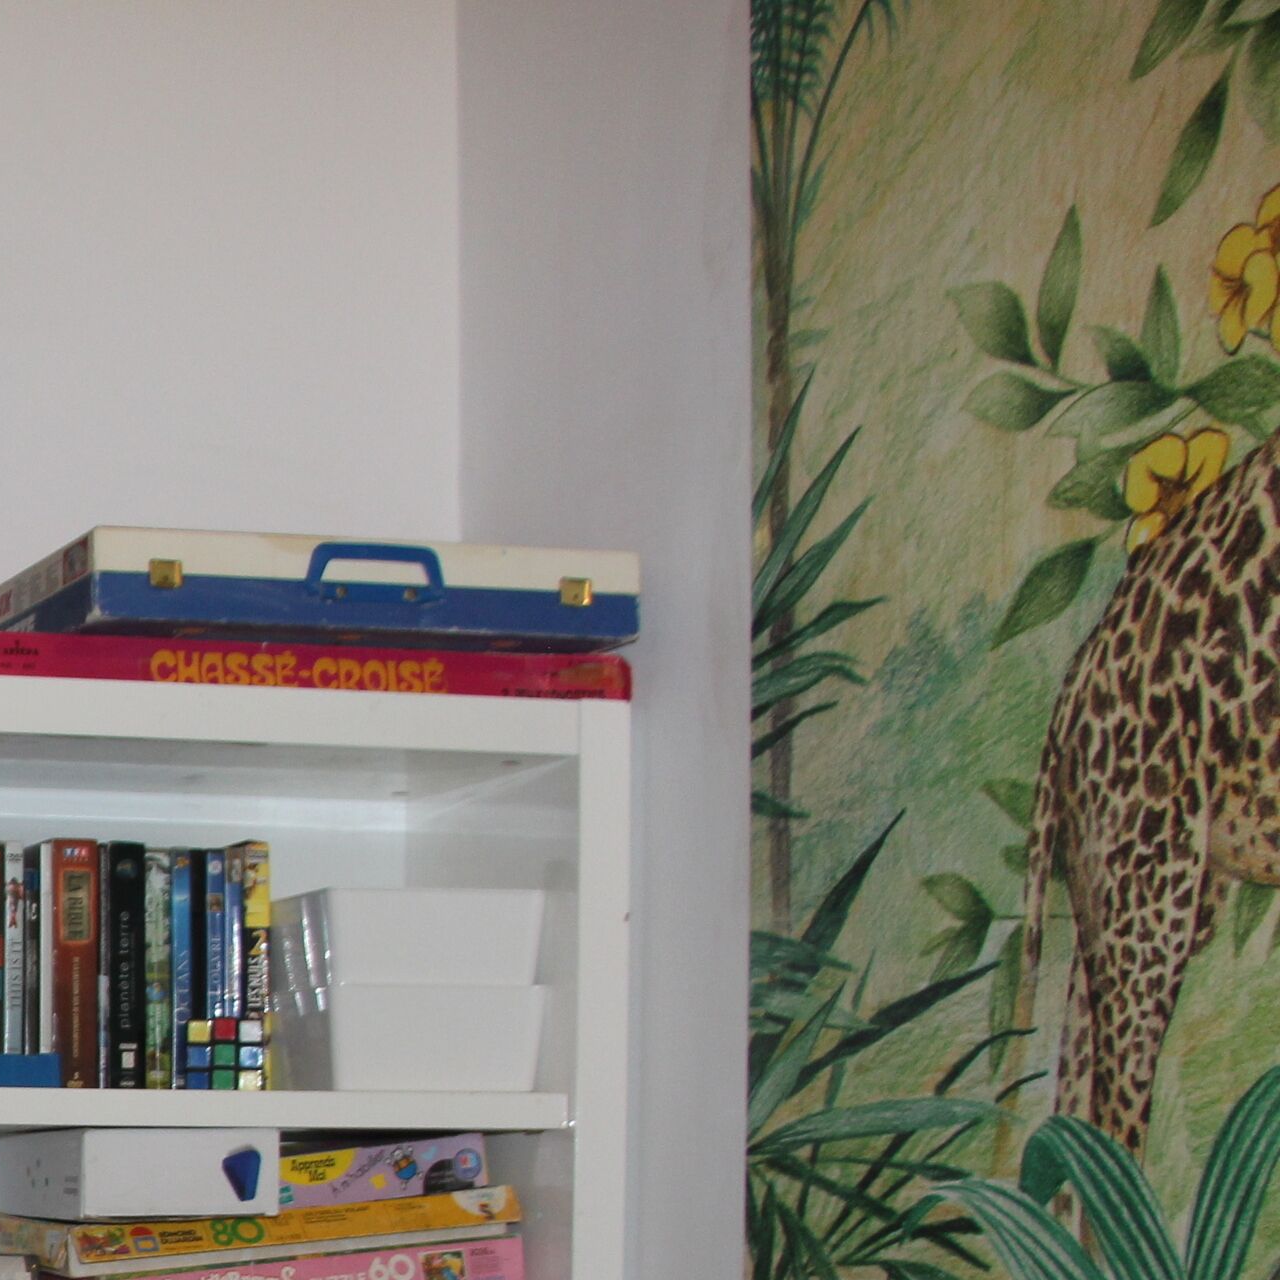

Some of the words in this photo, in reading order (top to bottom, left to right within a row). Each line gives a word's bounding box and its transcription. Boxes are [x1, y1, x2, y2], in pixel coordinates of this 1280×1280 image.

[11, 938, 22, 956] IT
[118, 910, 130, 954] terre
[10, 961, 21, 970] IS
[10, 974, 21, 1009] THIS
[118, 962, 131, 1028] planète
[210, 1217, 266, 1246] 80
